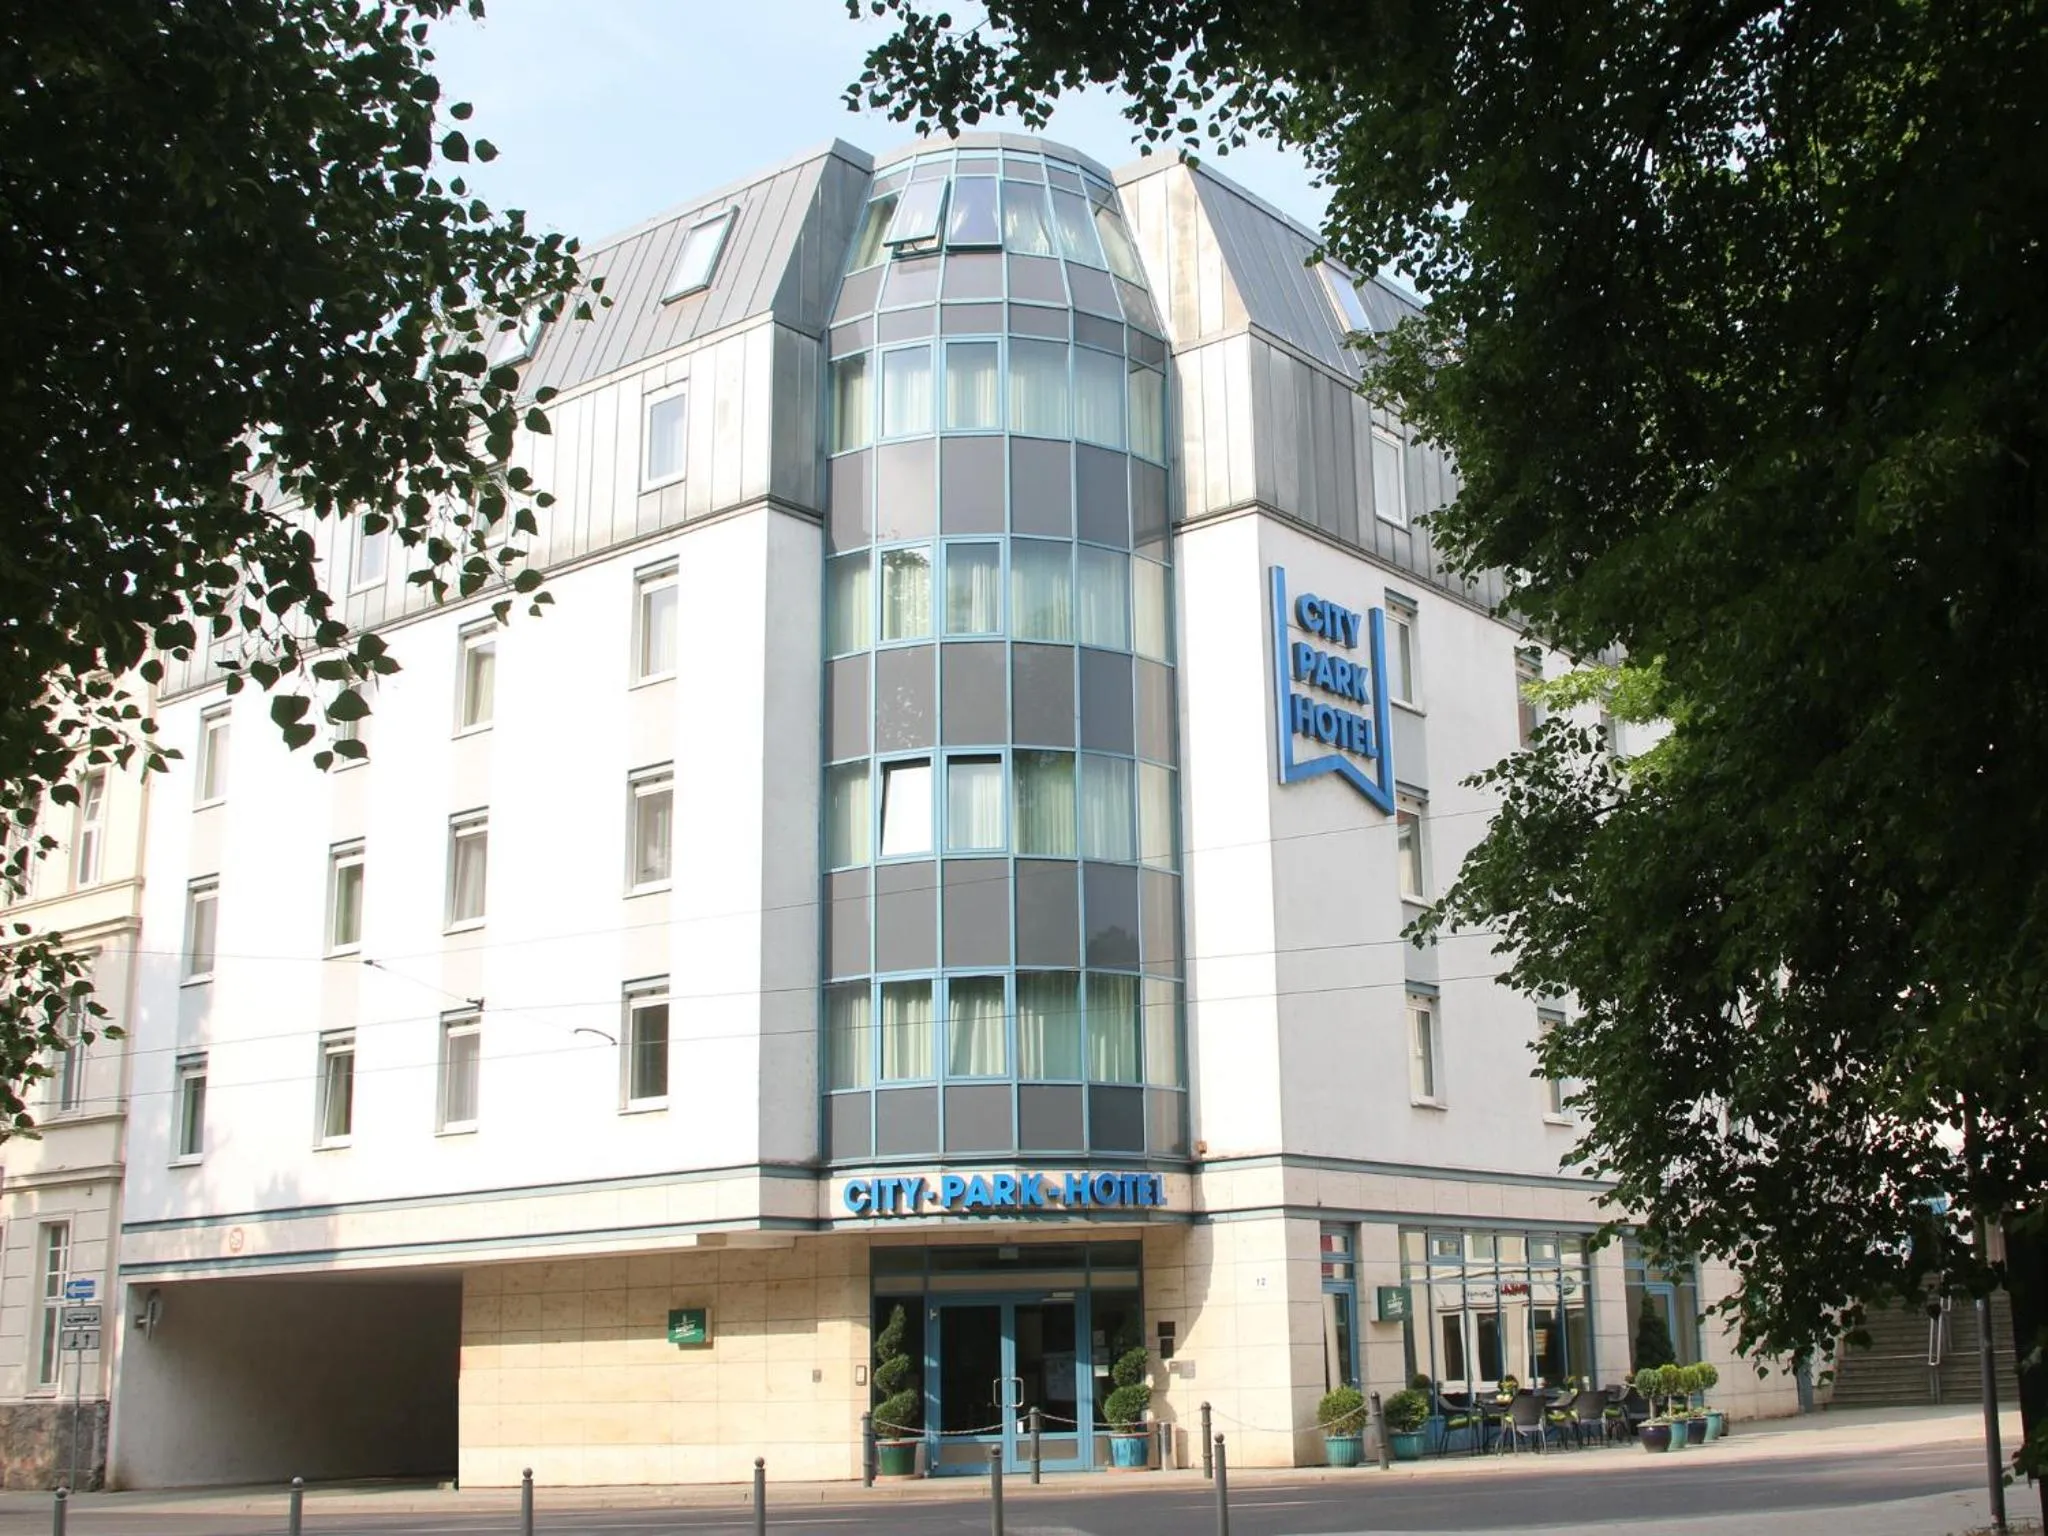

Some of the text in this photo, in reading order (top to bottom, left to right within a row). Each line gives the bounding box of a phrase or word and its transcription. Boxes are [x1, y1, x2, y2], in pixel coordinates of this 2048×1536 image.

[1295, 593, 1361, 648] CITY
[1292, 641, 1370, 704] PARK
[1291, 693, 1377, 759] HOTEL
